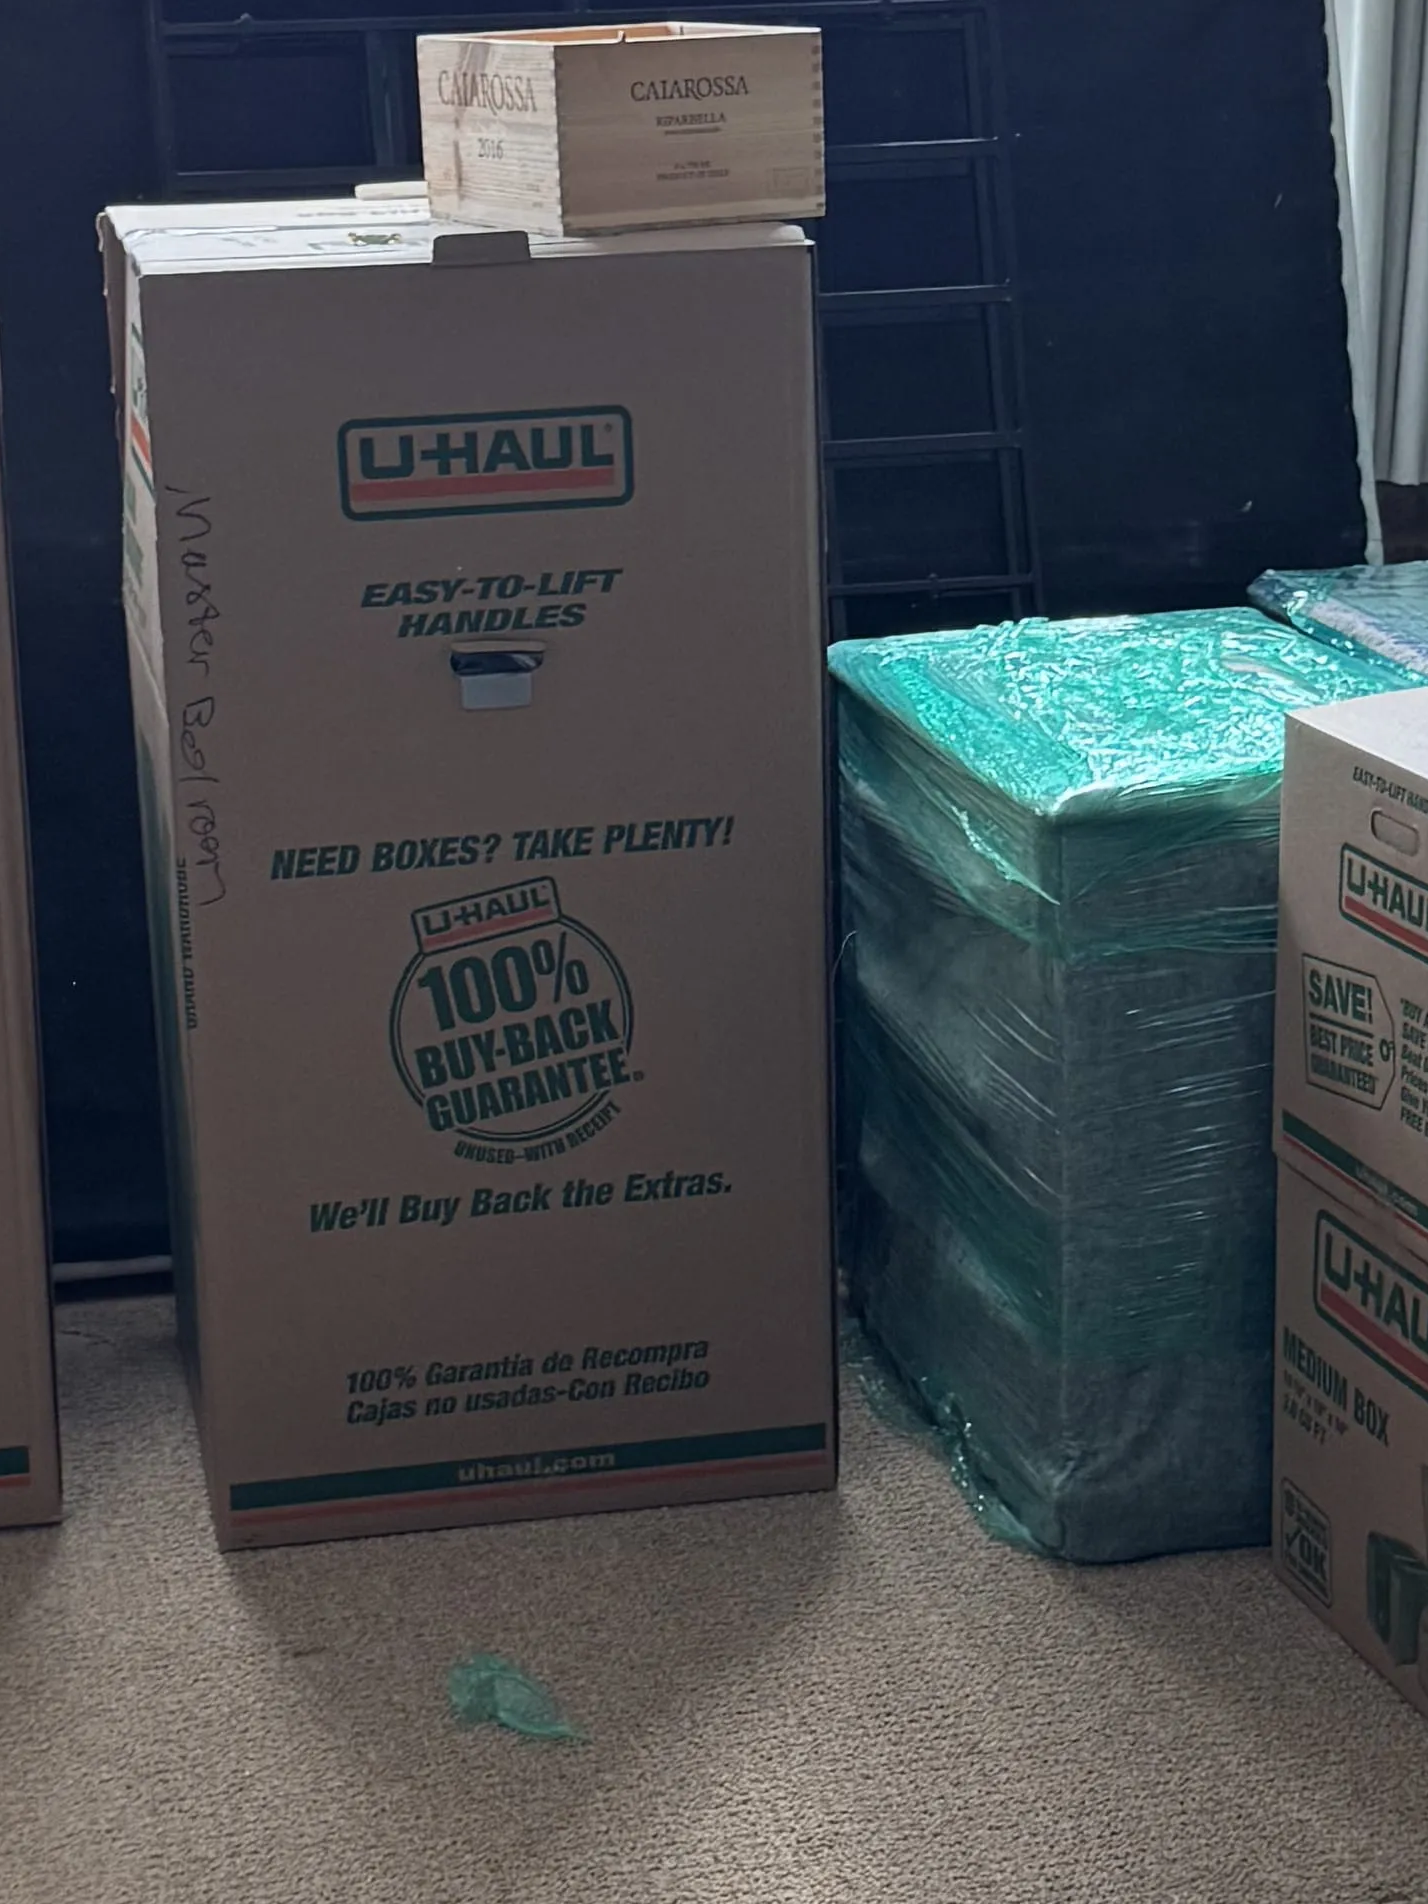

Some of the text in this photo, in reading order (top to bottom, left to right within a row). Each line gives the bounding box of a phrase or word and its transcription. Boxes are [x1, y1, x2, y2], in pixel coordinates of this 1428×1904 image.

[438, 70, 538, 116] CAIAROSSA
[629, 74, 750, 102] CAIAROSSA
[358, 423, 615, 481] U-HAUL
[360, 568, 624, 608] EASY-TO-LIFT
[397, 604, 587, 638] HANDLES
[270, 815, 735, 880] NEED BOXES? TAKE PLENTY!
[422, 886, 550, 936] U-HAUL
[418, 930, 590, 1032] 100%
[1308, 968, 1374, 1024] SAVE!
[414, 999, 620, 1089] BUY-BACK
[1310, 1023, 1339, 1055] BEST
[426, 1047, 631, 1132] GUARANTEE
[309, 1169, 732, 1233] We'll Buy Back the Extras.
[346, 1339, 710, 1394] 100% de Recompra
[1282, 1325, 1347, 1411] MEDIUM
[1354, 1386, 1390, 1447] BOX
[346, 1398, 416, 1426] Cajas
[425, 1394, 457, 1416] no
[624, 1367, 711, 1396] Recibo
[457, 1451, 616, 1483] uhaul.com
